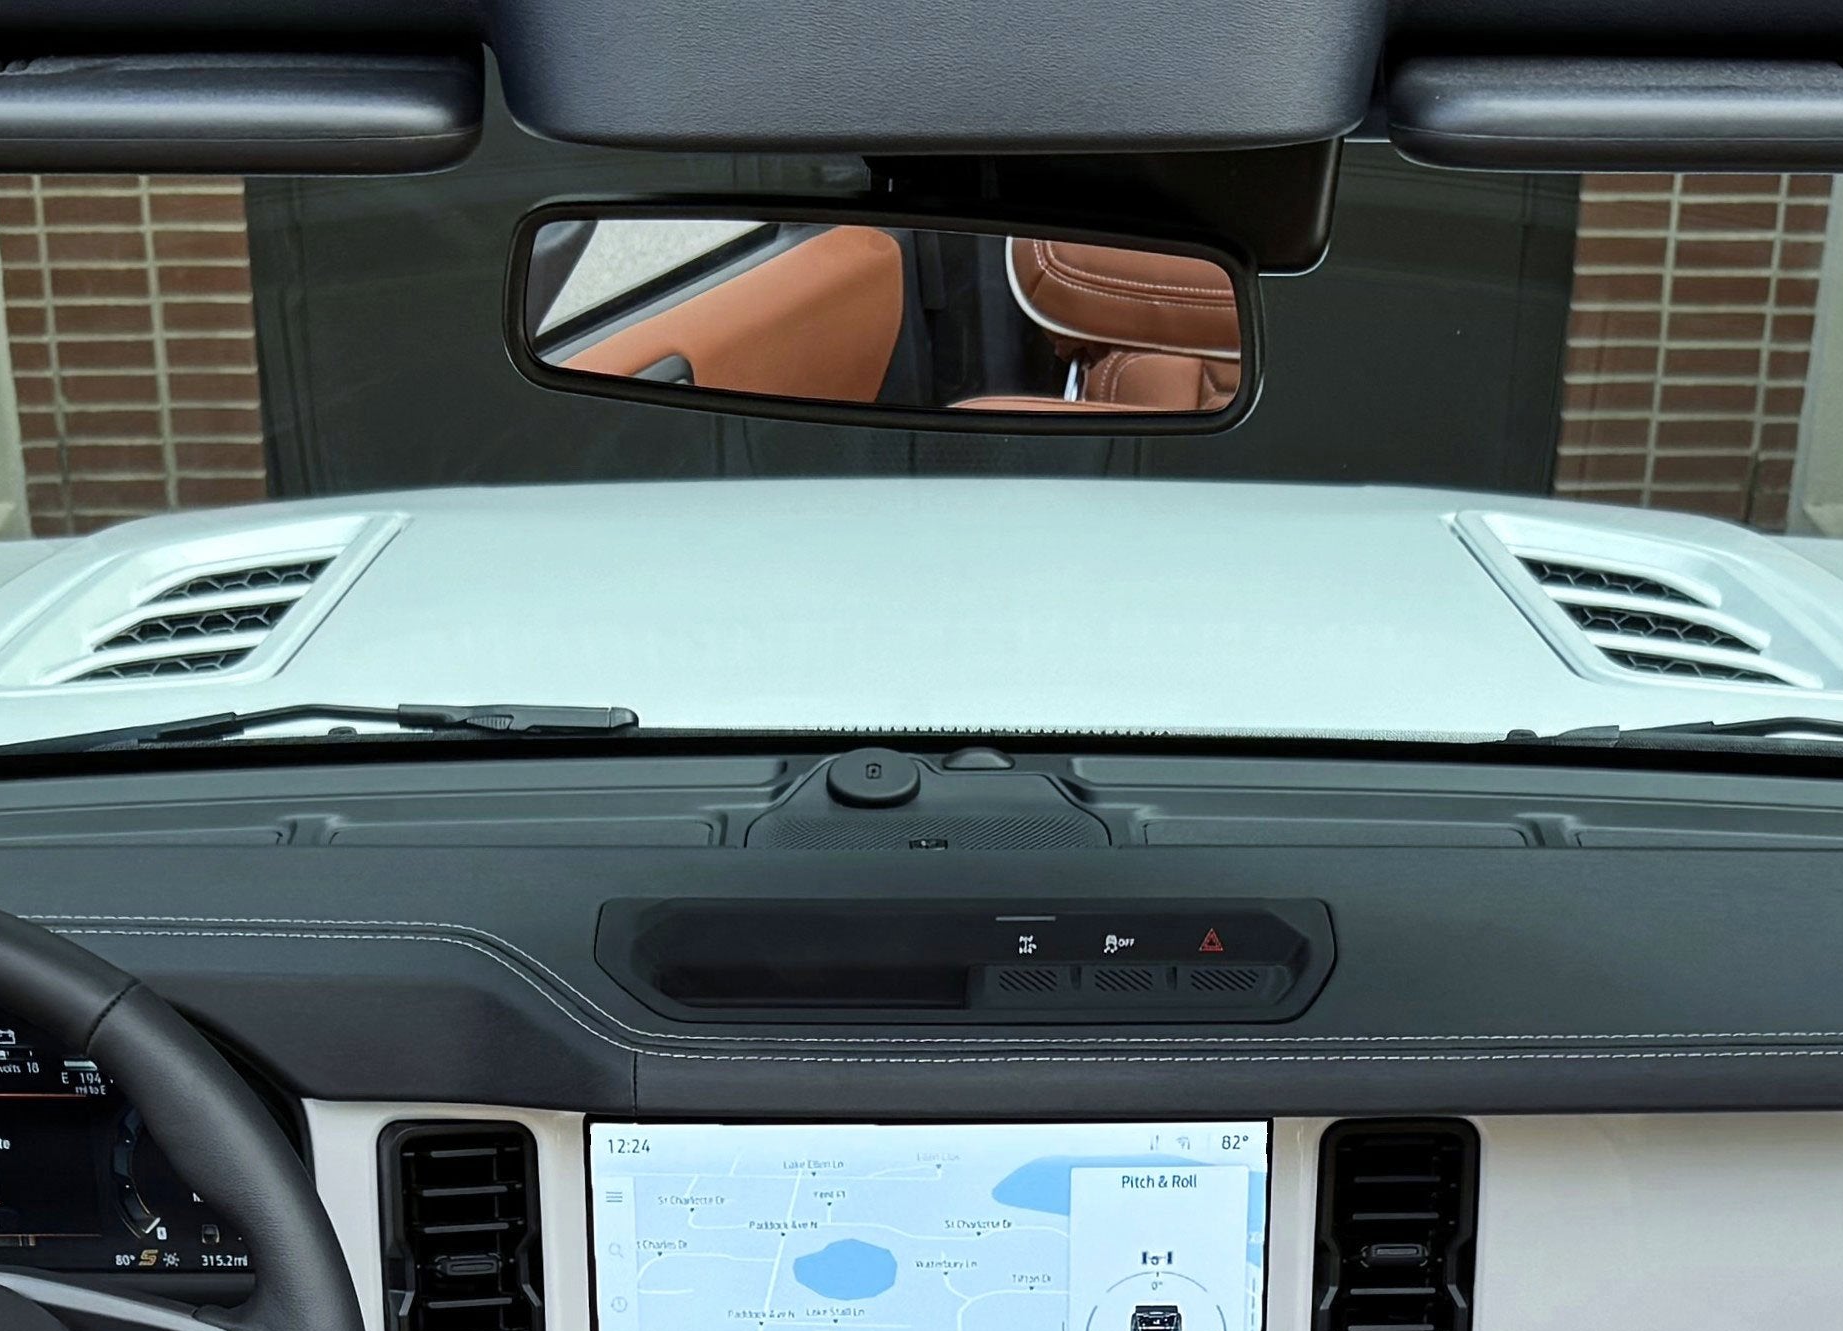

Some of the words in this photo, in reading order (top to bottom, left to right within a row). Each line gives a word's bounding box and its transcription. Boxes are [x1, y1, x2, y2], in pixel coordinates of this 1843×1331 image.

[1118, 938, 1135, 947] OFF
[61, 1072, 69, 1083] E
[80, 1072, 101, 1084] 194
[608, 1139, 650, 1153] 12:24
[1221, 1135, 1249, 1150] 82°
[1121, 1175, 1155, 1188] Pitch
[1158, 1175, 1168, 1188] &
[1172, 1175, 1197, 1188] Roll
